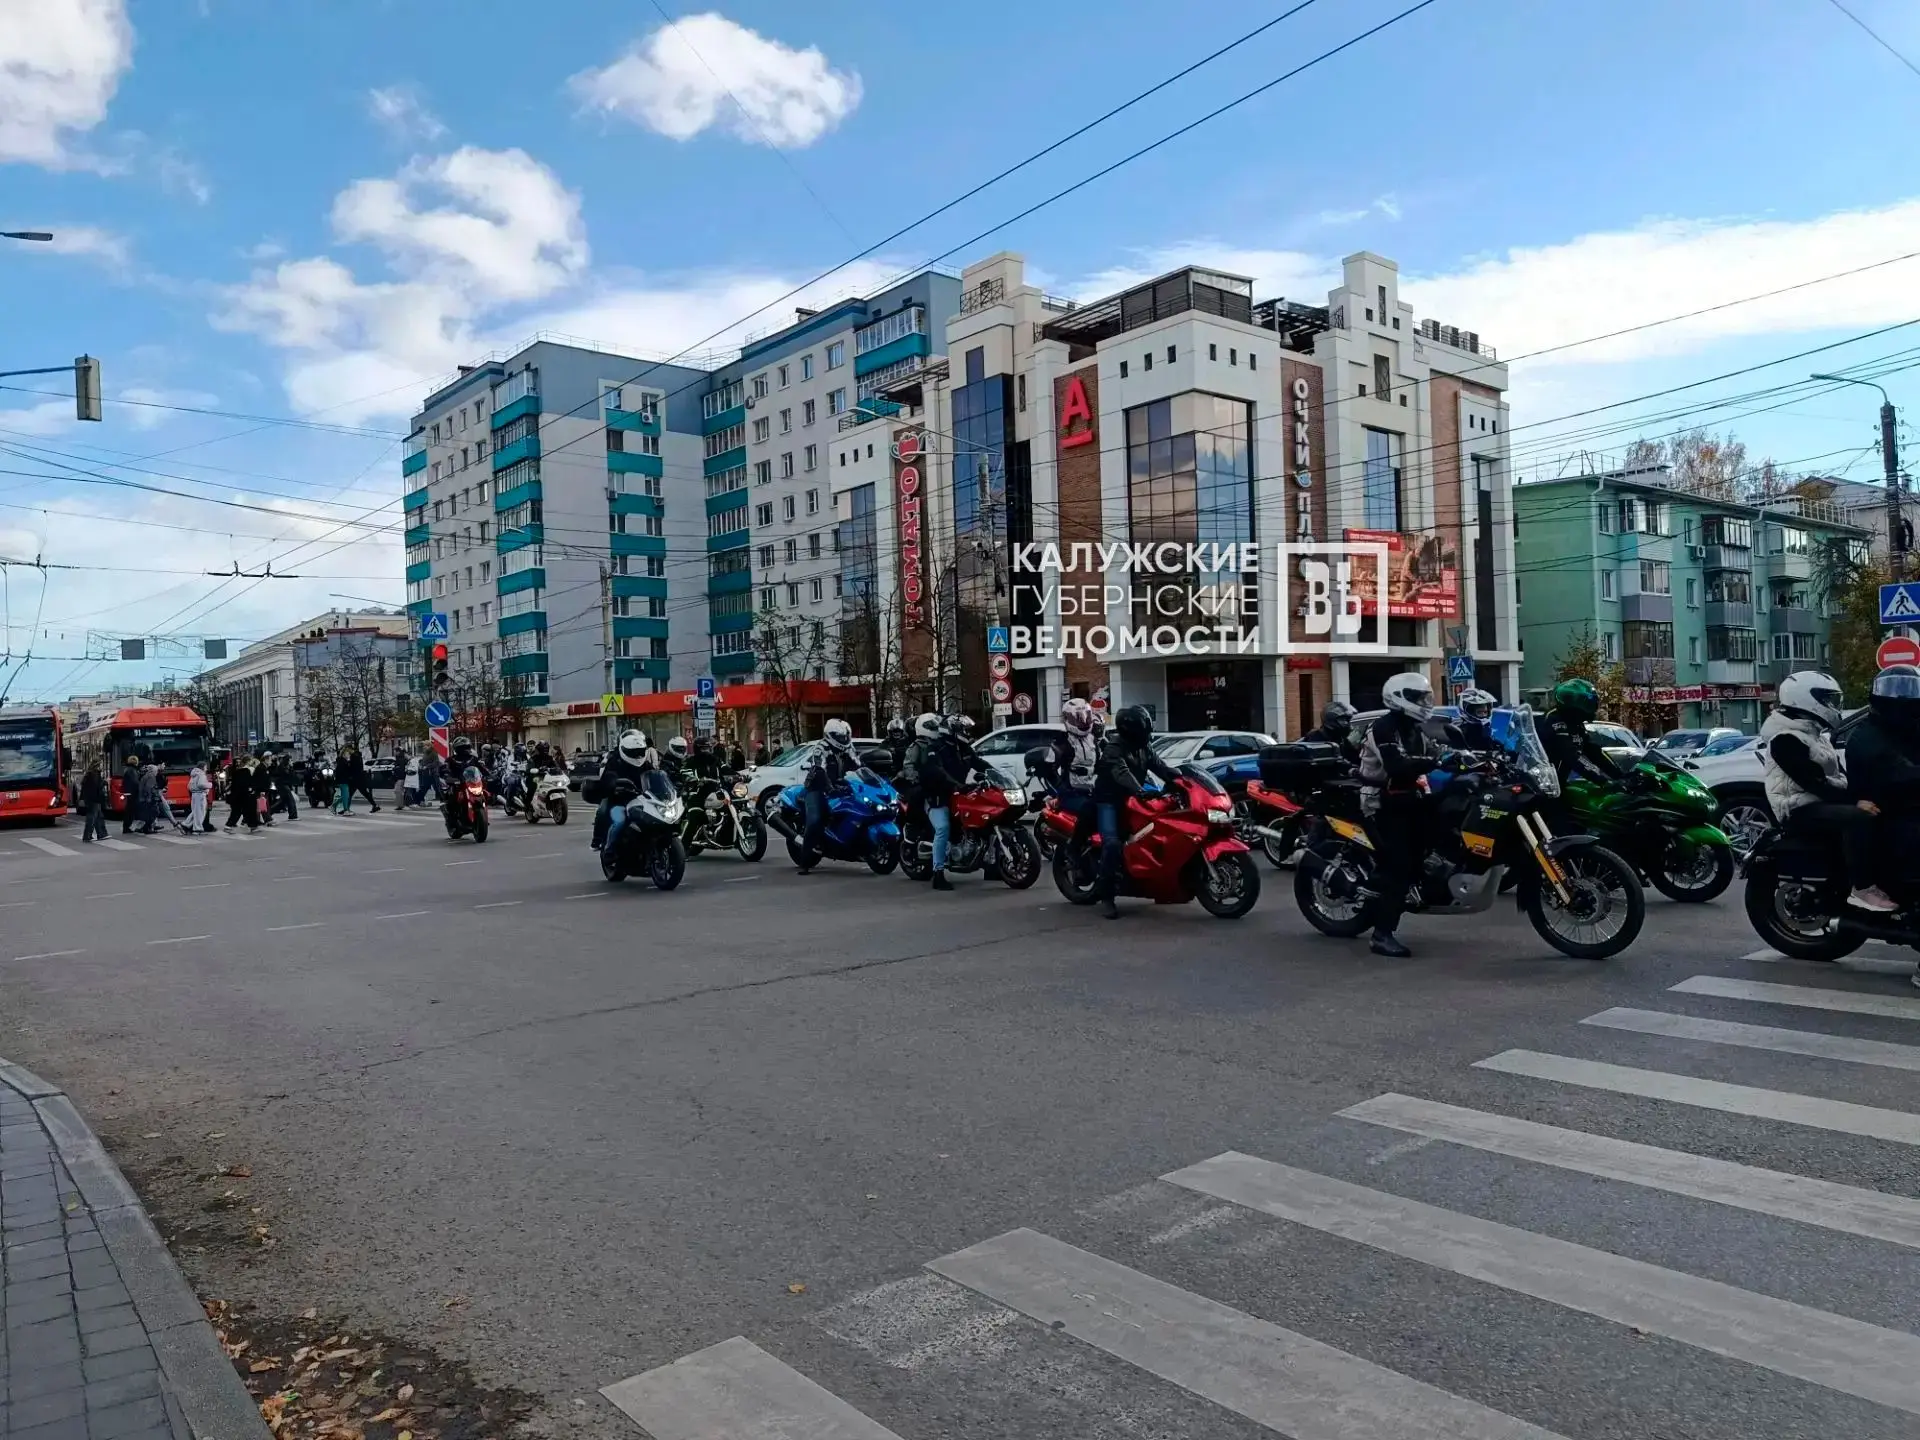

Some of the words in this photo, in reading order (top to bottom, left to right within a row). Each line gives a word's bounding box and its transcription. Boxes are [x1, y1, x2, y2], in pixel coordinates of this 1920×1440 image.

[1061, 376, 1092, 427] А
[1293, 377, 1311, 467] ОЧКИ
[702, 680, 712, 696] P
